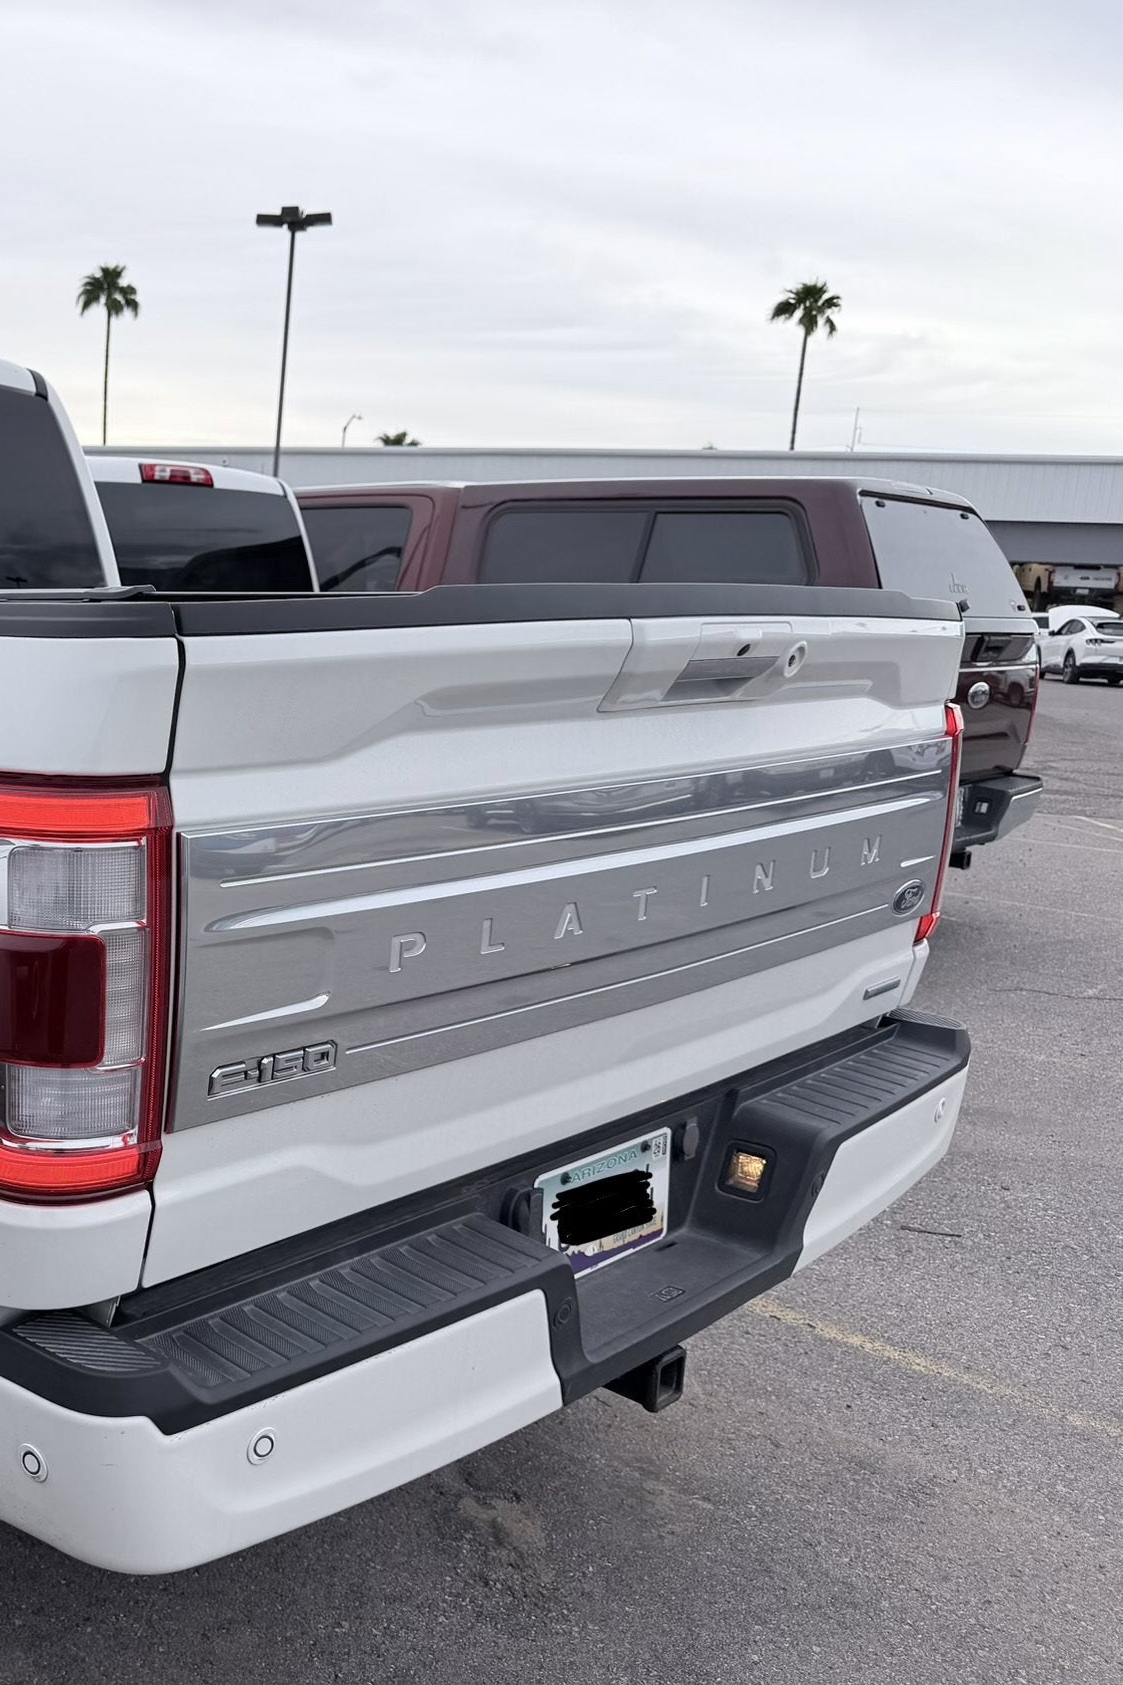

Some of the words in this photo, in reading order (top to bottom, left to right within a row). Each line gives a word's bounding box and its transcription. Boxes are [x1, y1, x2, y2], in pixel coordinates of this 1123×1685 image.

[388, 834, 883, 973] PLATINUM
[207, 1039, 338, 1098] F-150
[571, 1149, 639, 1184] ARIZONA
